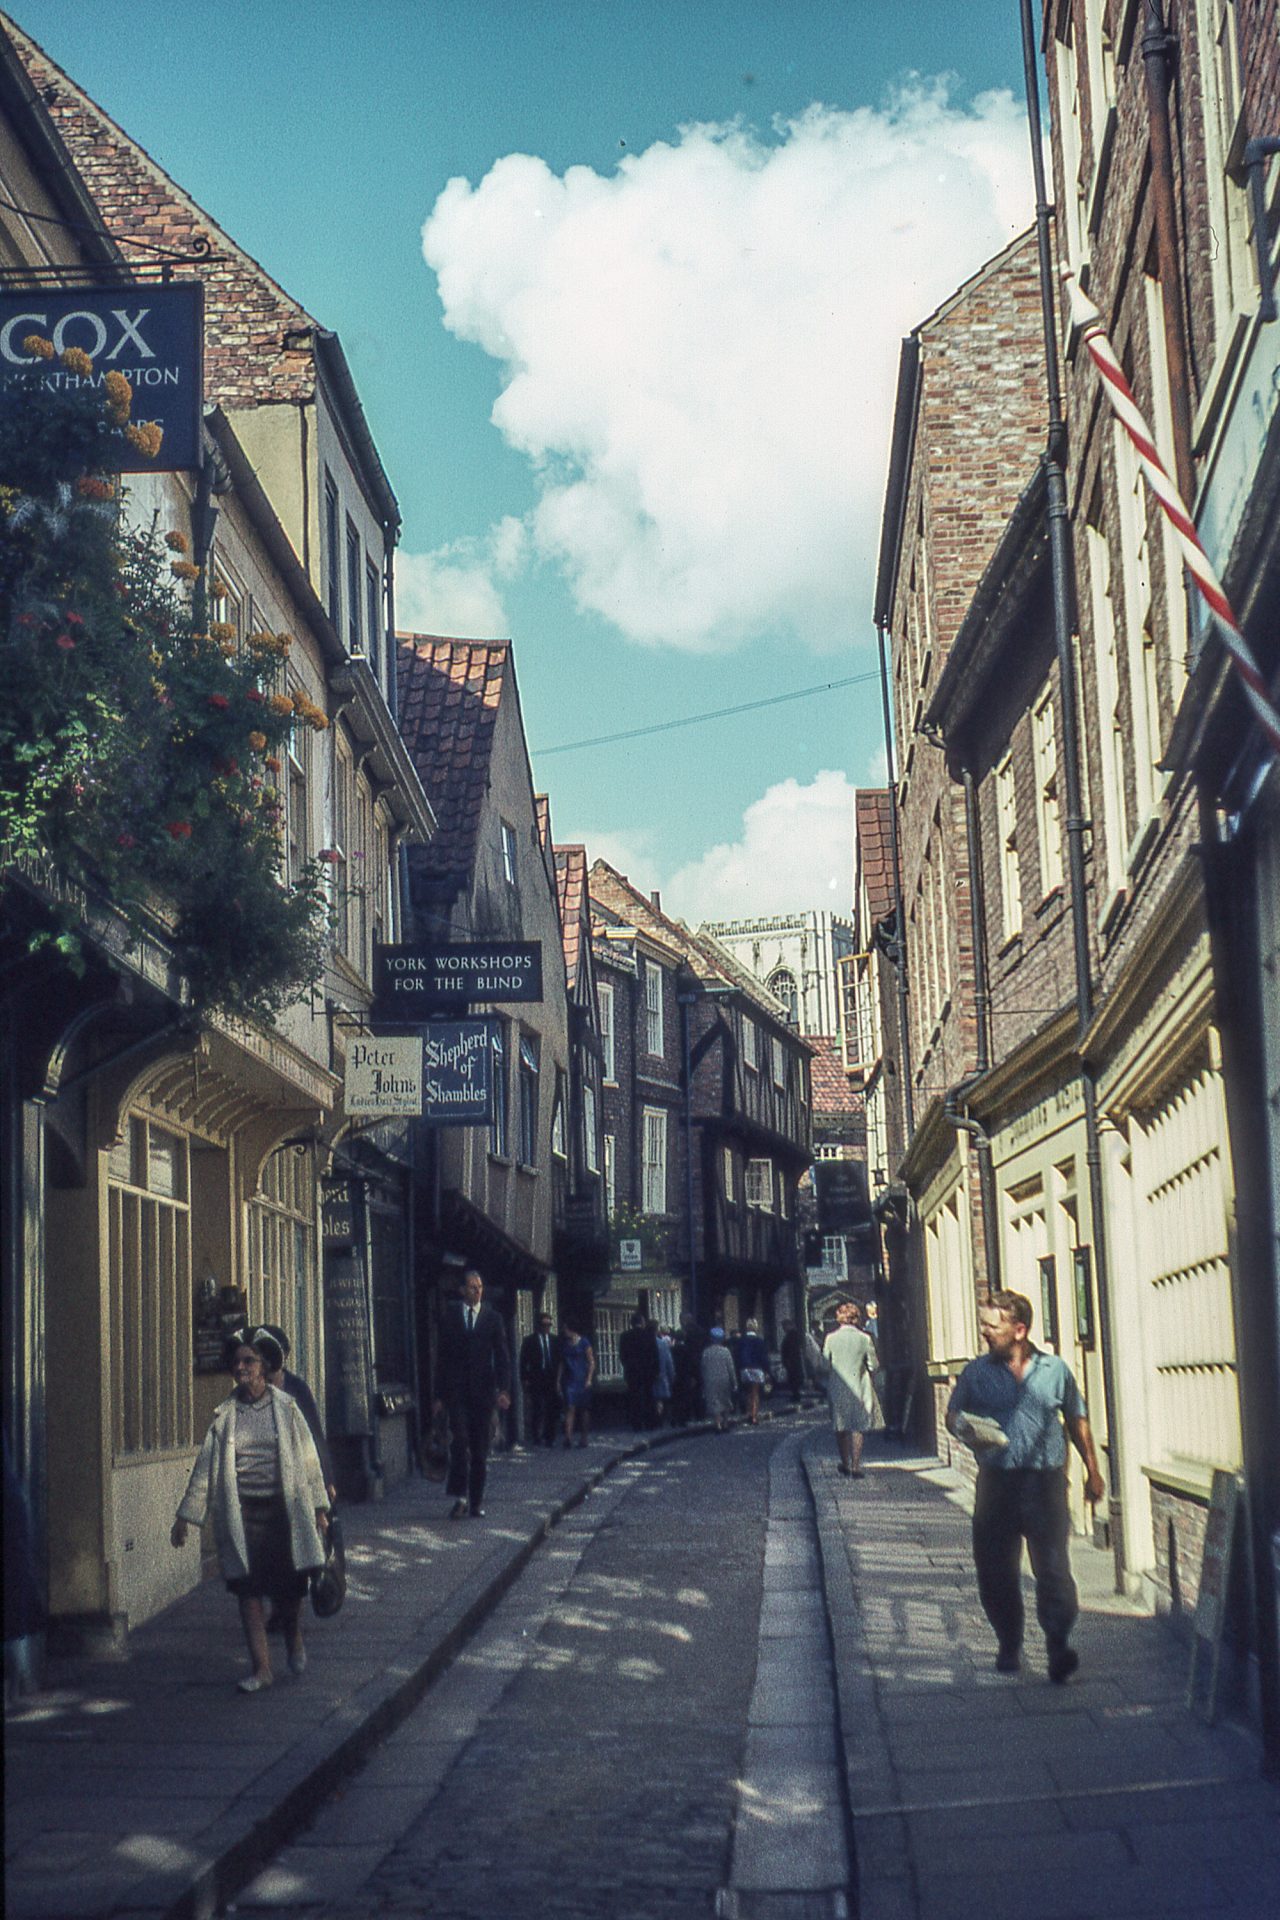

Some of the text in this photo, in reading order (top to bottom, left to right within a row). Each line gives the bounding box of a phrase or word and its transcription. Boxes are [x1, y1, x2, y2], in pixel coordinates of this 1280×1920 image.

[1, 309, 156, 365] COX
[386, 956, 532, 971] YORK WORKSHOPS
[395, 976, 523, 991] FOR THE BLIND
[352, 1045, 395, 1069] Peter
[425, 1025, 488, 1070] Shepherd
[460, 1055, 478, 1080] of
[425, 1080, 488, 1104] Shambles
